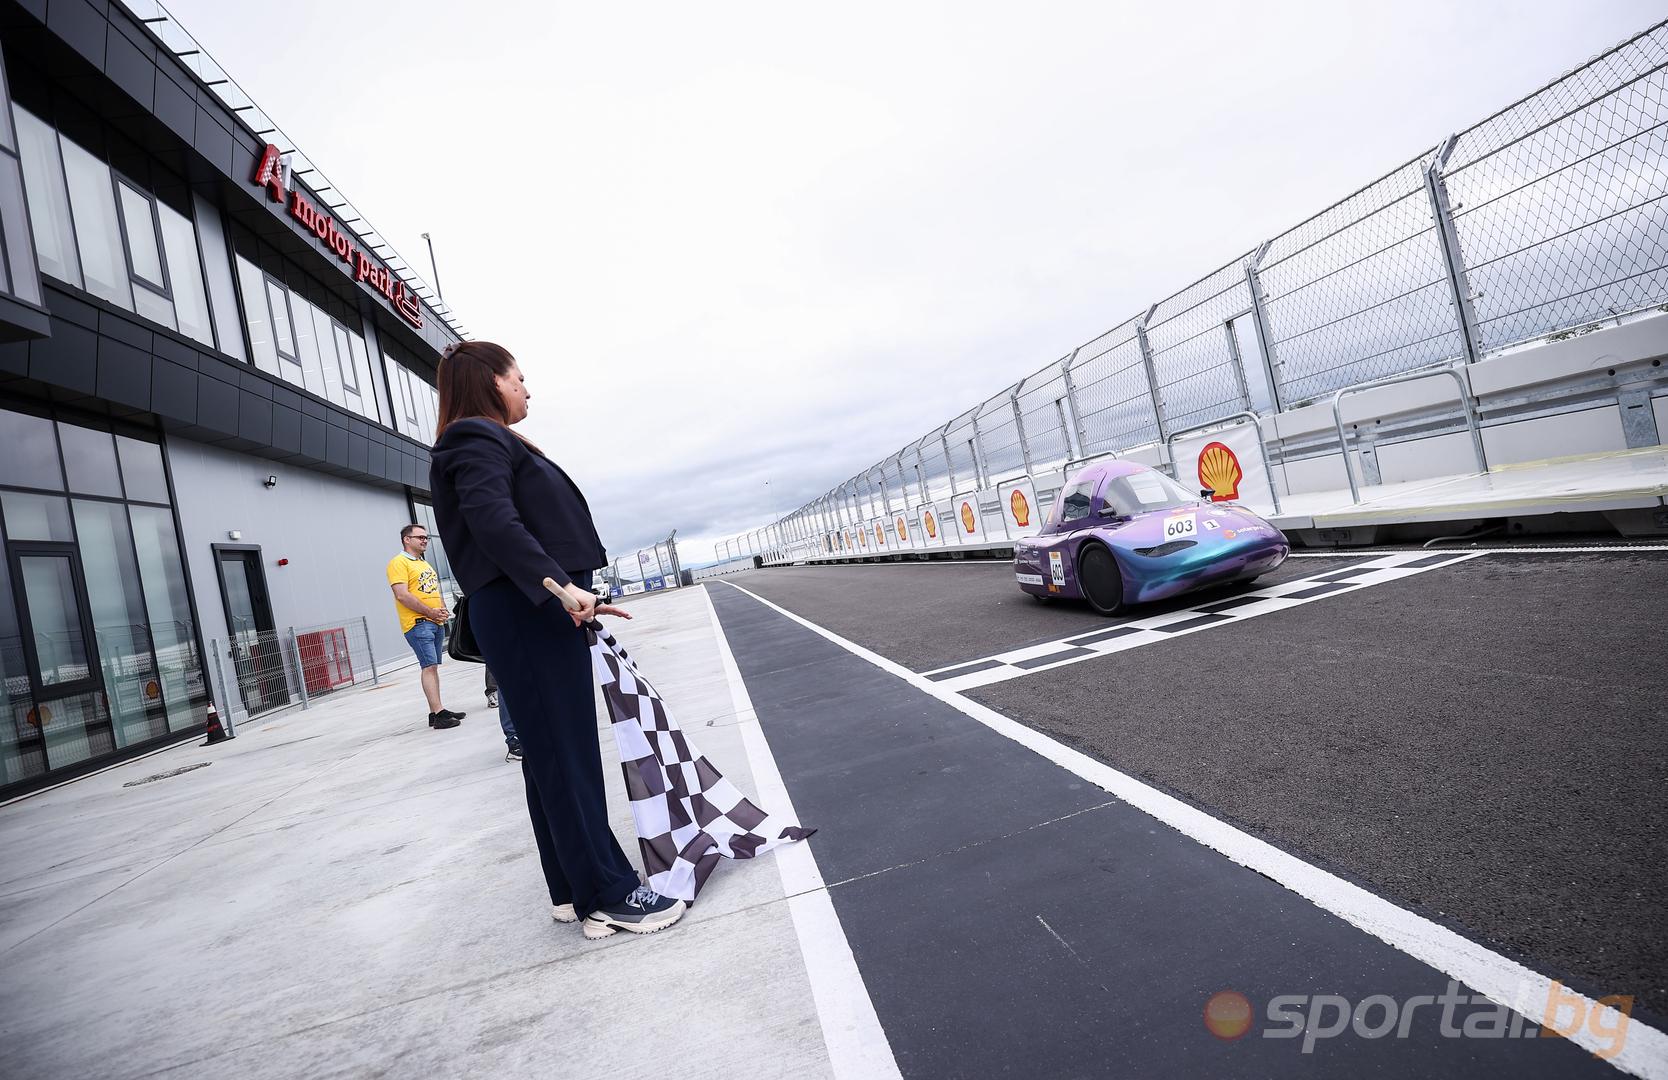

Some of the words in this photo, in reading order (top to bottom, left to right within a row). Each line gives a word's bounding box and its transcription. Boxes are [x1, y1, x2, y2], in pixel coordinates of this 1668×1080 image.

[291, 191, 358, 265] motor
[356, 249, 396, 301] park
[1167, 519, 1193, 536] 603
[1206, 521, 1218, 529] 1
[1052, 563, 1064, 581] 603
